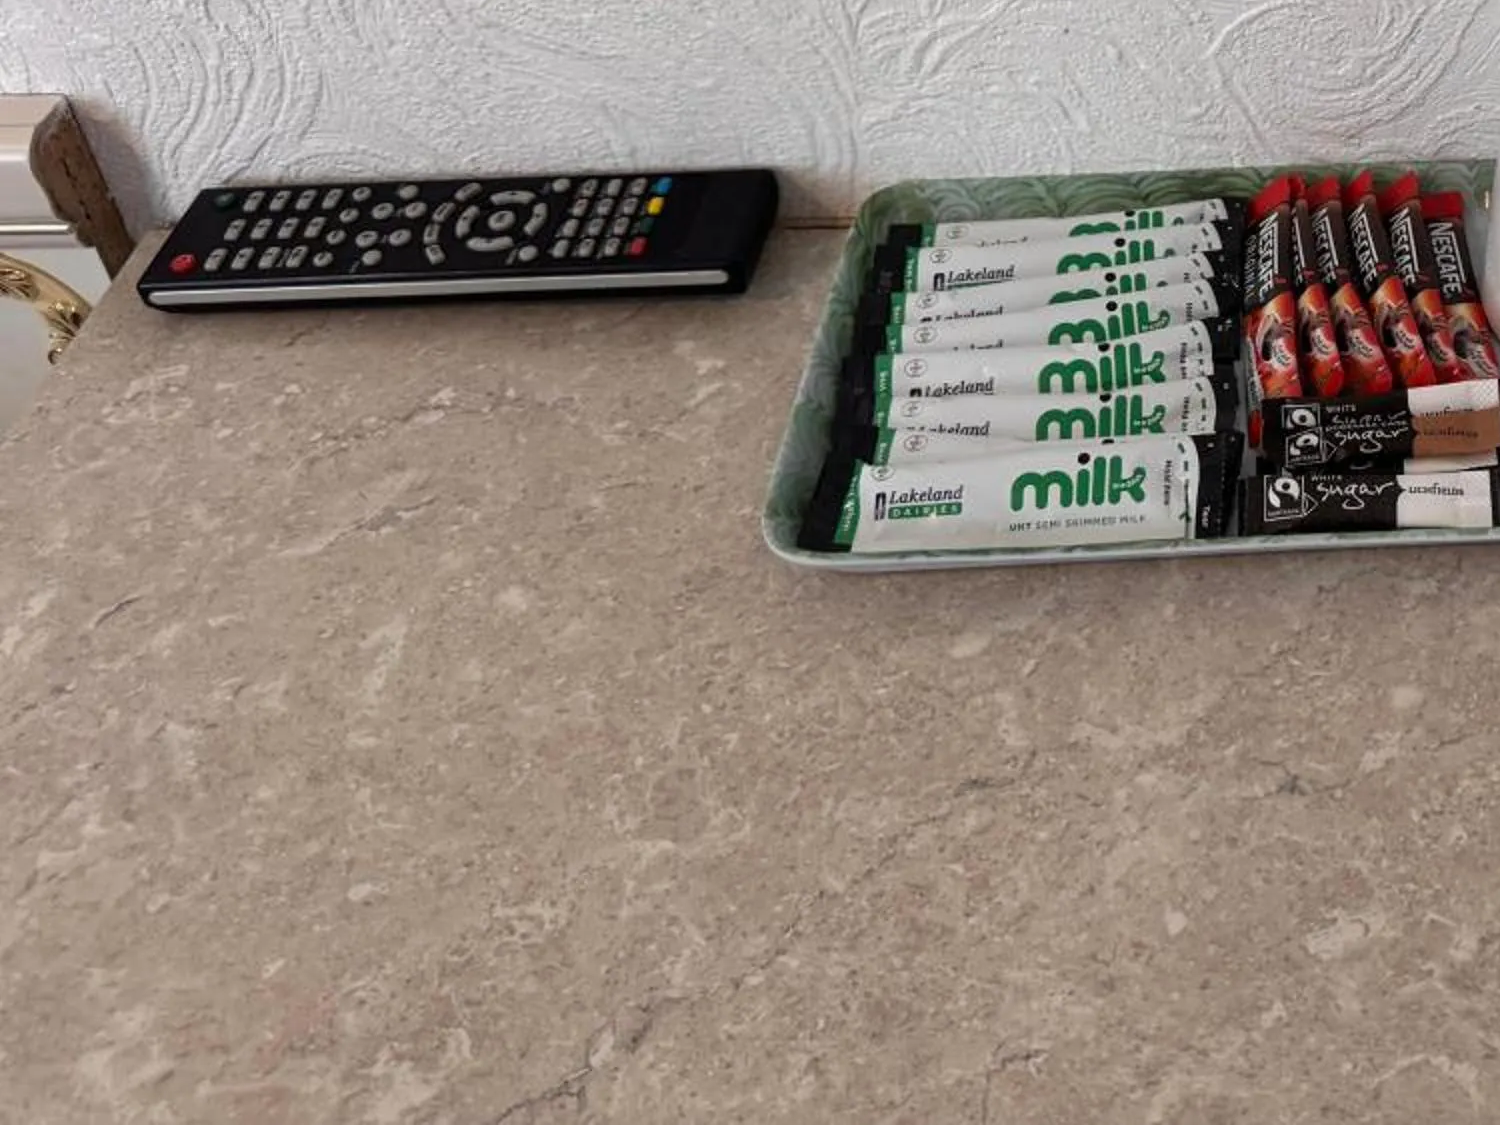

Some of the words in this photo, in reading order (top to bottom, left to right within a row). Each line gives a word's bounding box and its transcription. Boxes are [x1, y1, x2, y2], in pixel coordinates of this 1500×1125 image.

[947, 265, 1016, 284] Lakeland
[1038, 342, 1167, 394] milk
[926, 376, 996, 398] Lakeland
[1035, 394, 1167, 441] milk
[1334, 426, 1409, 454] sugar
[889, 485, 964, 505] Lakeland
[1010, 452, 1147, 512] milk
[1316, 481, 1394, 511] sugar
[1009, 521, 1032, 532] UHT
[1036, 518, 1062, 530] SEMI
[1065, 515, 1117, 528] SKIMMED
